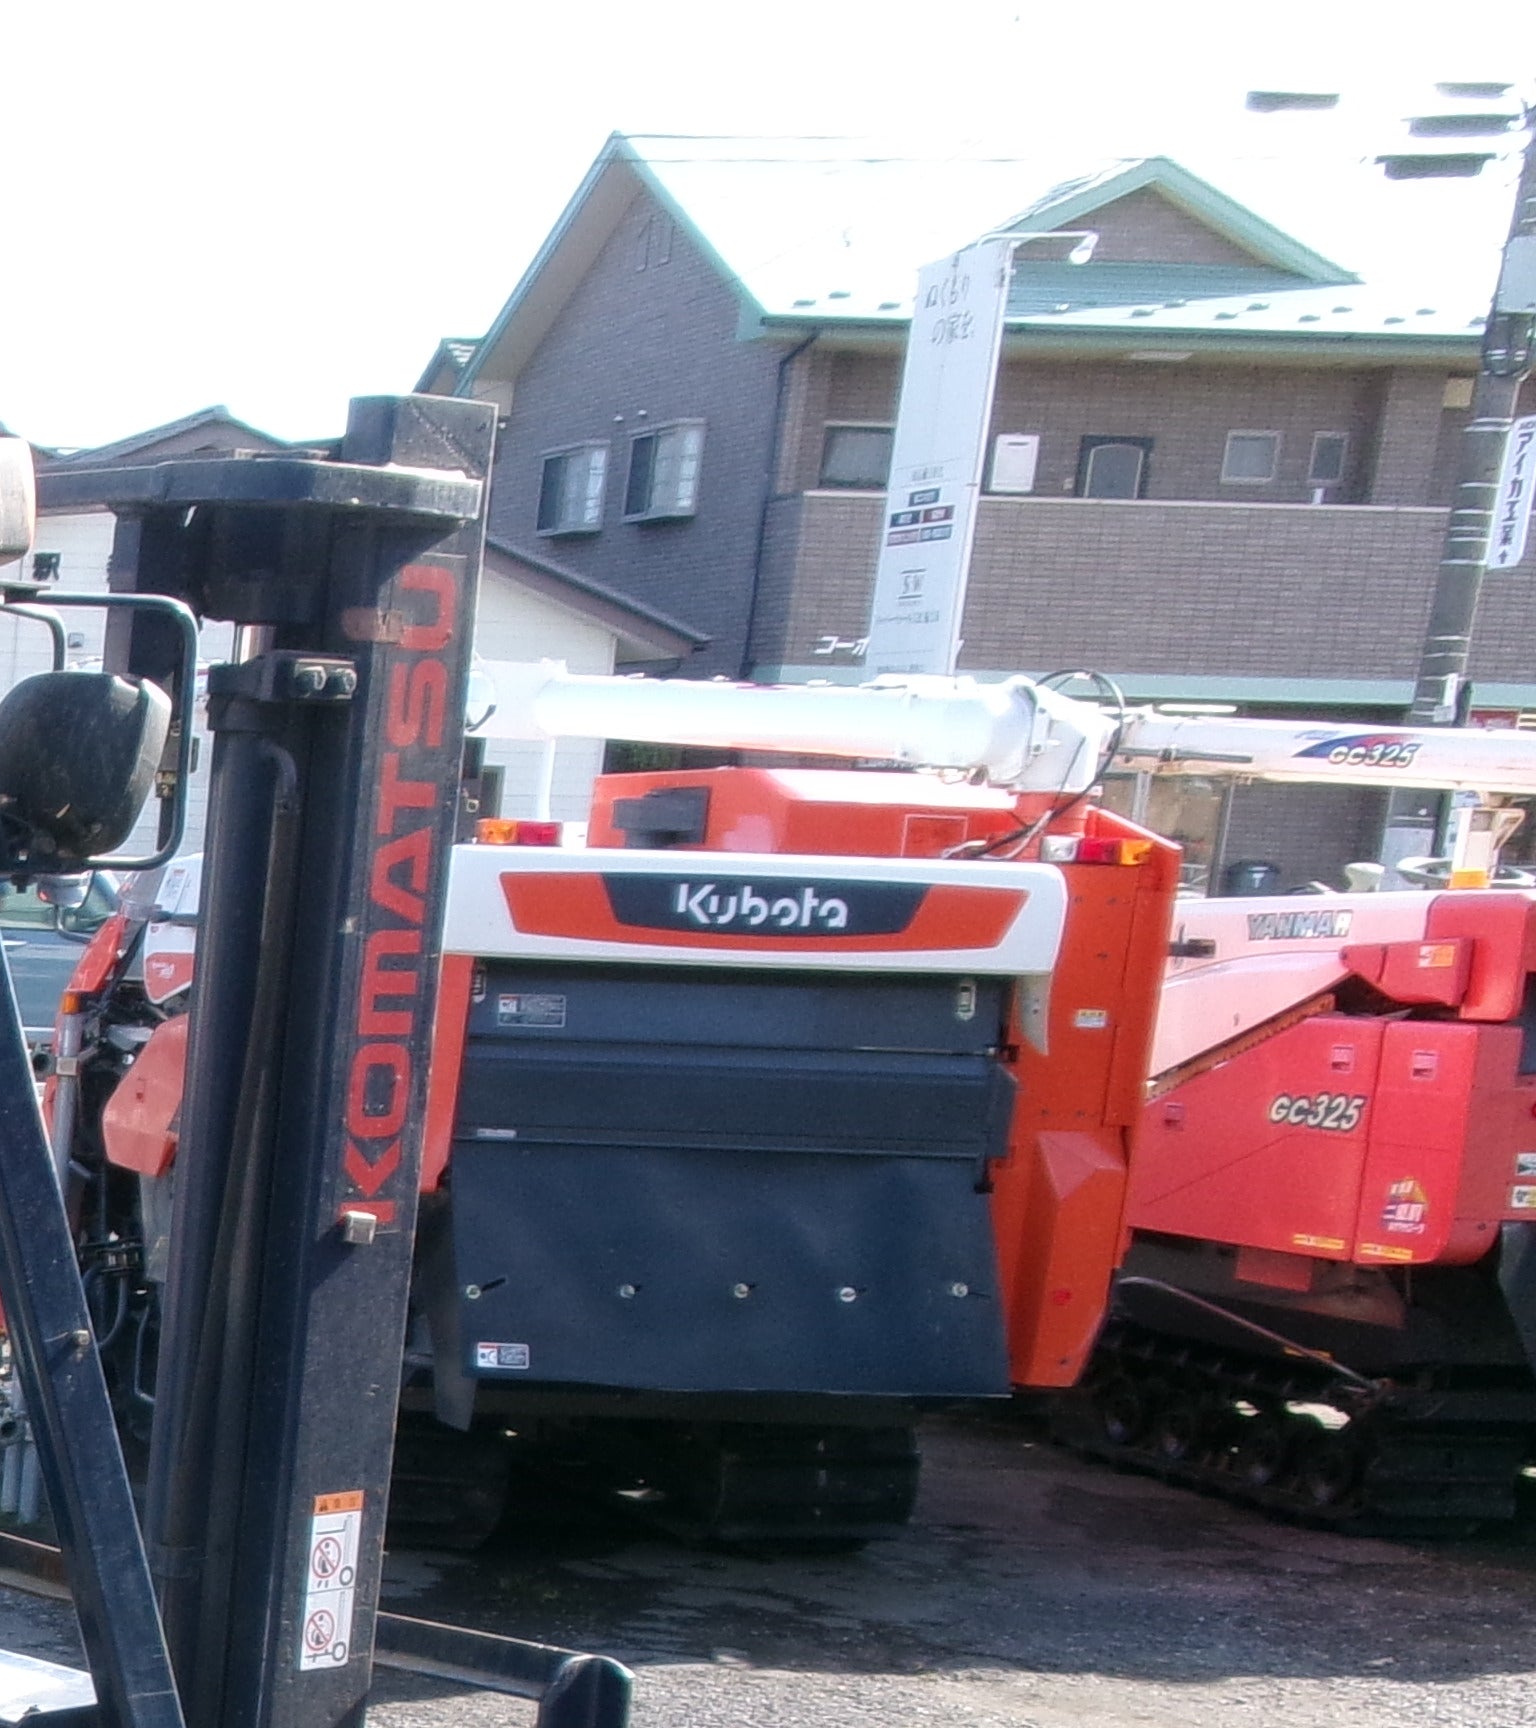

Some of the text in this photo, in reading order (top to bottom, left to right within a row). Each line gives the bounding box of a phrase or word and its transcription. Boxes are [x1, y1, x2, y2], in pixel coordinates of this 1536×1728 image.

[339, 563, 459, 1223] KOMATSU
[676, 882, 849, 928] Kubota
[1246, 909, 1354, 941] YANMAR
[1266, 1091, 1368, 1133] GC325
